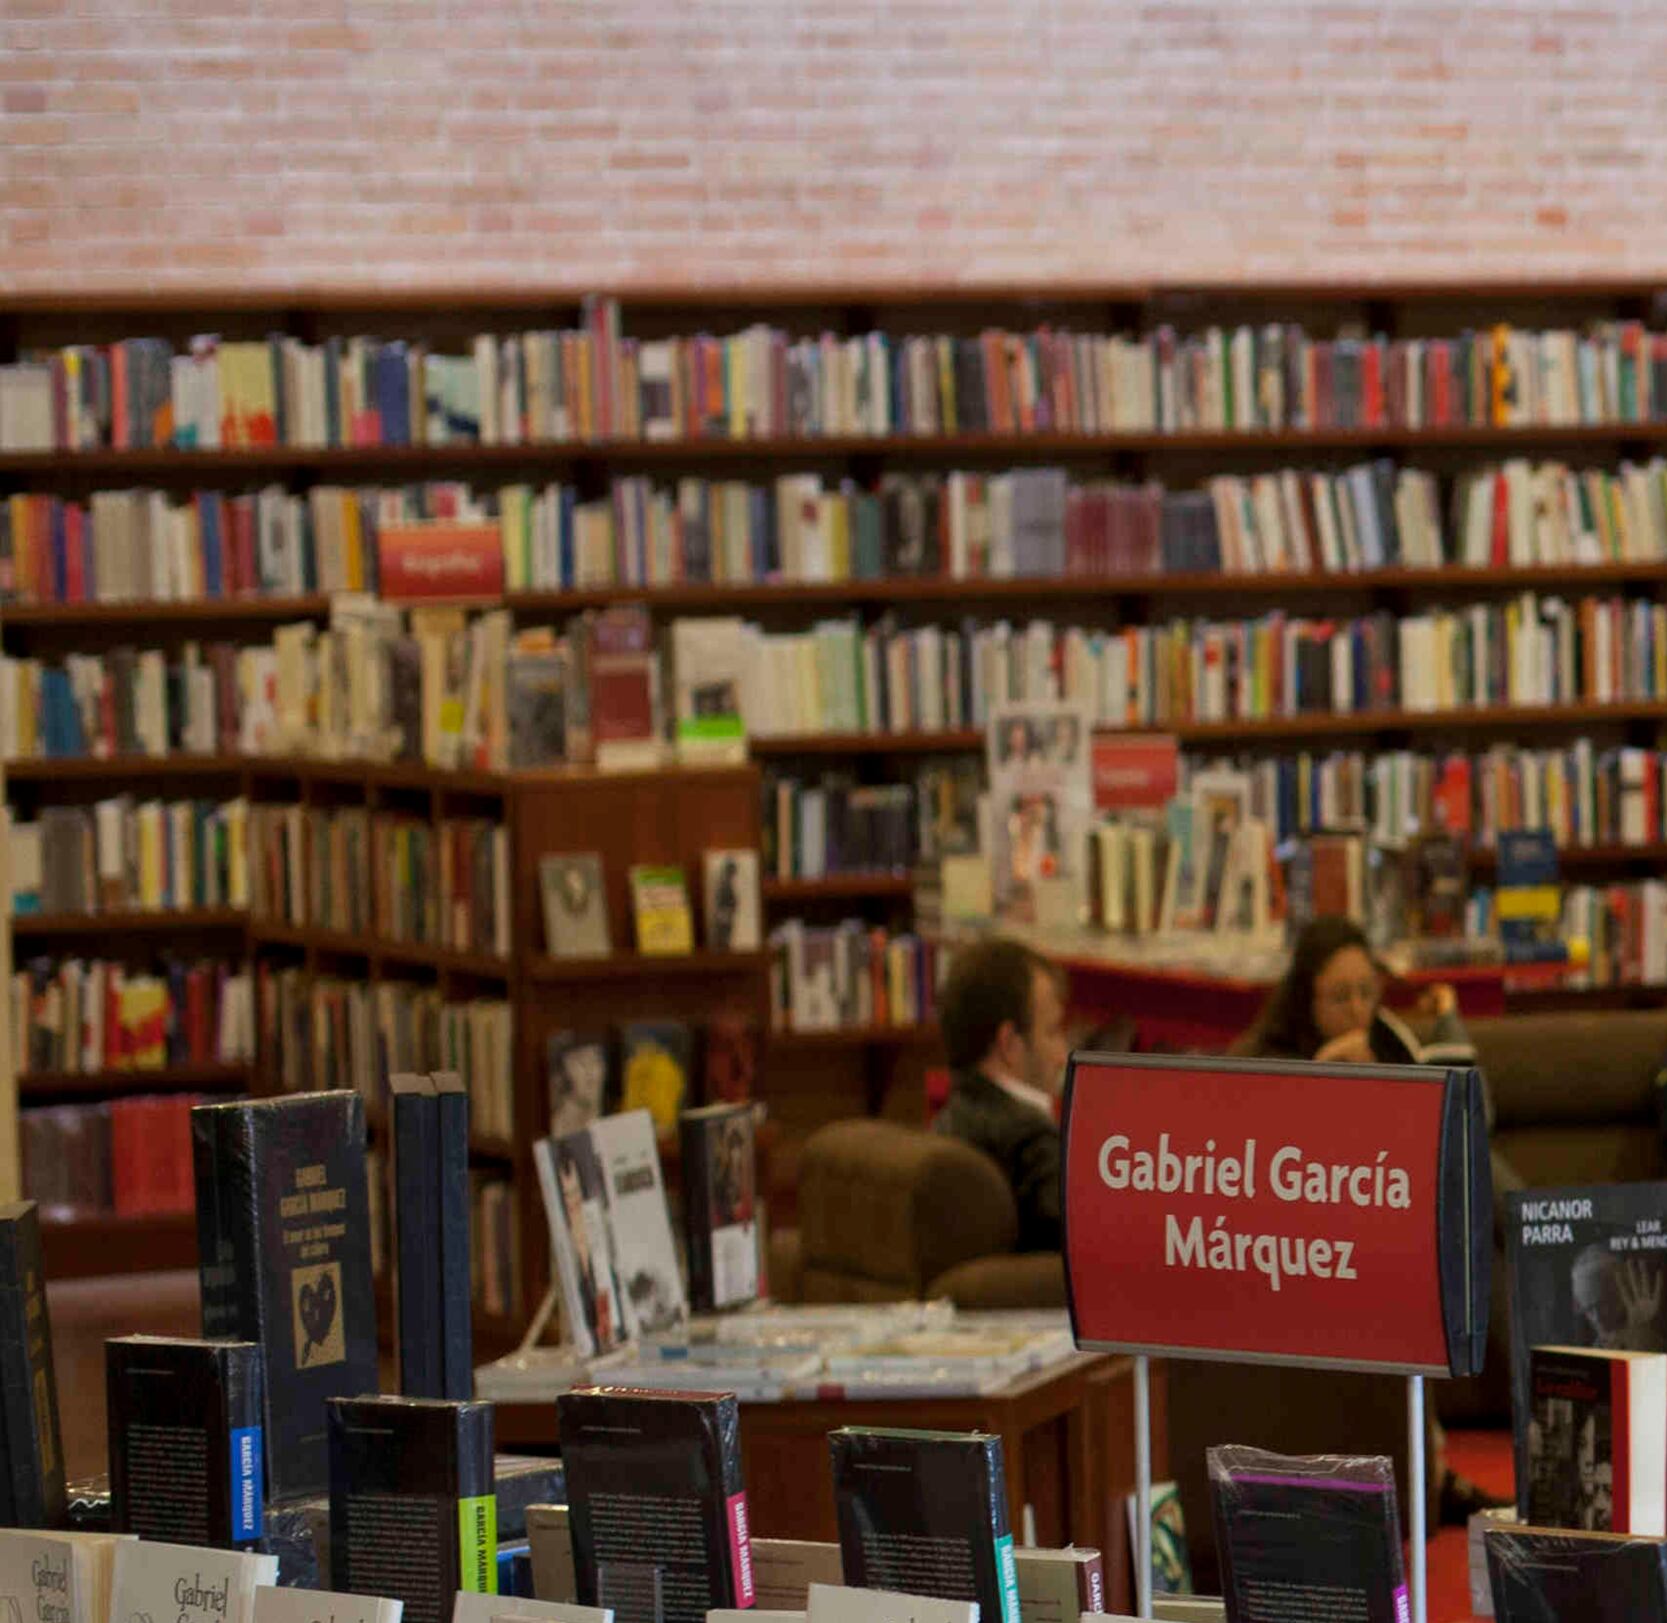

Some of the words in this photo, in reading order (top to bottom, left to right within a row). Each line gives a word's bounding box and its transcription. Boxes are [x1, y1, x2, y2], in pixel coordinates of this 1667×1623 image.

[1098, 1132, 1257, 1199] Gabriel
[1269, 1145, 1412, 1209] García
[1521, 1200, 1594, 1222] NICANOR
[1636, 1220, 1661, 1235] LEAR
[1164, 1214, 1358, 1292] Márquez
[1522, 1223, 1574, 1246] PARRA
[31, 1555, 68, 1593] Gabriel
[174, 1573, 229, 1618] Gabriel
